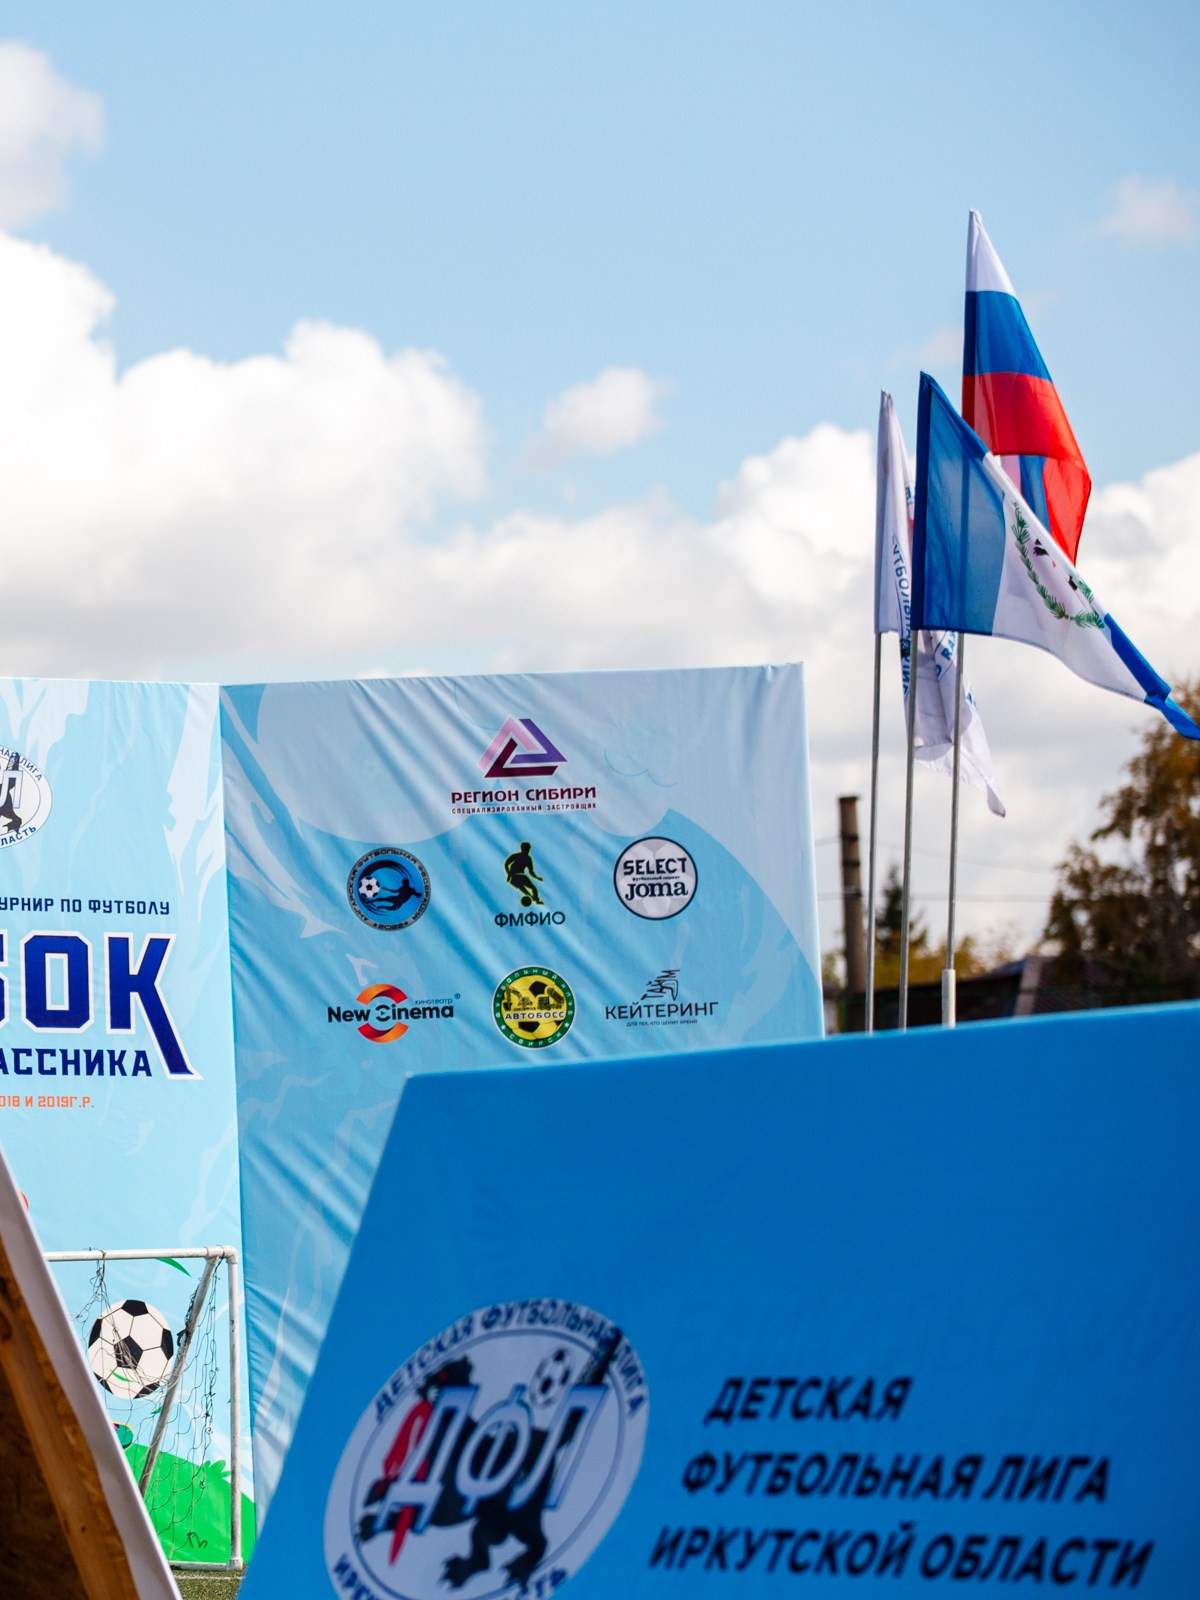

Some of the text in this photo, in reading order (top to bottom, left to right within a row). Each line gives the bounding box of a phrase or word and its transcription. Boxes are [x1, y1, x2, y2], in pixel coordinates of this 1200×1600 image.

[18, 757, 43, 782] ЛИГА
[451, 786, 597, 804] РЕГИОН СИБИРИ
[451, 802, 597, 815] СПЕЦИАЛИЗИРОВАННЫЙ ЗАСТРОЙЩИК
[623, 857, 687, 876] SELECT
[60, 898, 82, 913] ПО
[88, 899, 170, 916] ФУТБОЛУ
[494, 911, 566, 927] ФМФИО
[327, 1003, 454, 1023] New Cinema
[505, 1011, 565, 1020] АВТОБОСС
[605, 1001, 719, 1020] КЕЙТЕРИНГ
[24, 1095, 34, 1107] И
[703, 1375, 912, 1426] ДЕТСКАЯ
[373, 1383, 609, 1534] ДФЛ
[681, 1451, 1111, 1504] ФУТБОЛЬНАЯ ЛИГА
[648, 1521, 1155, 1589] ИРКУТСКОЙ ОБЛАСТИ
